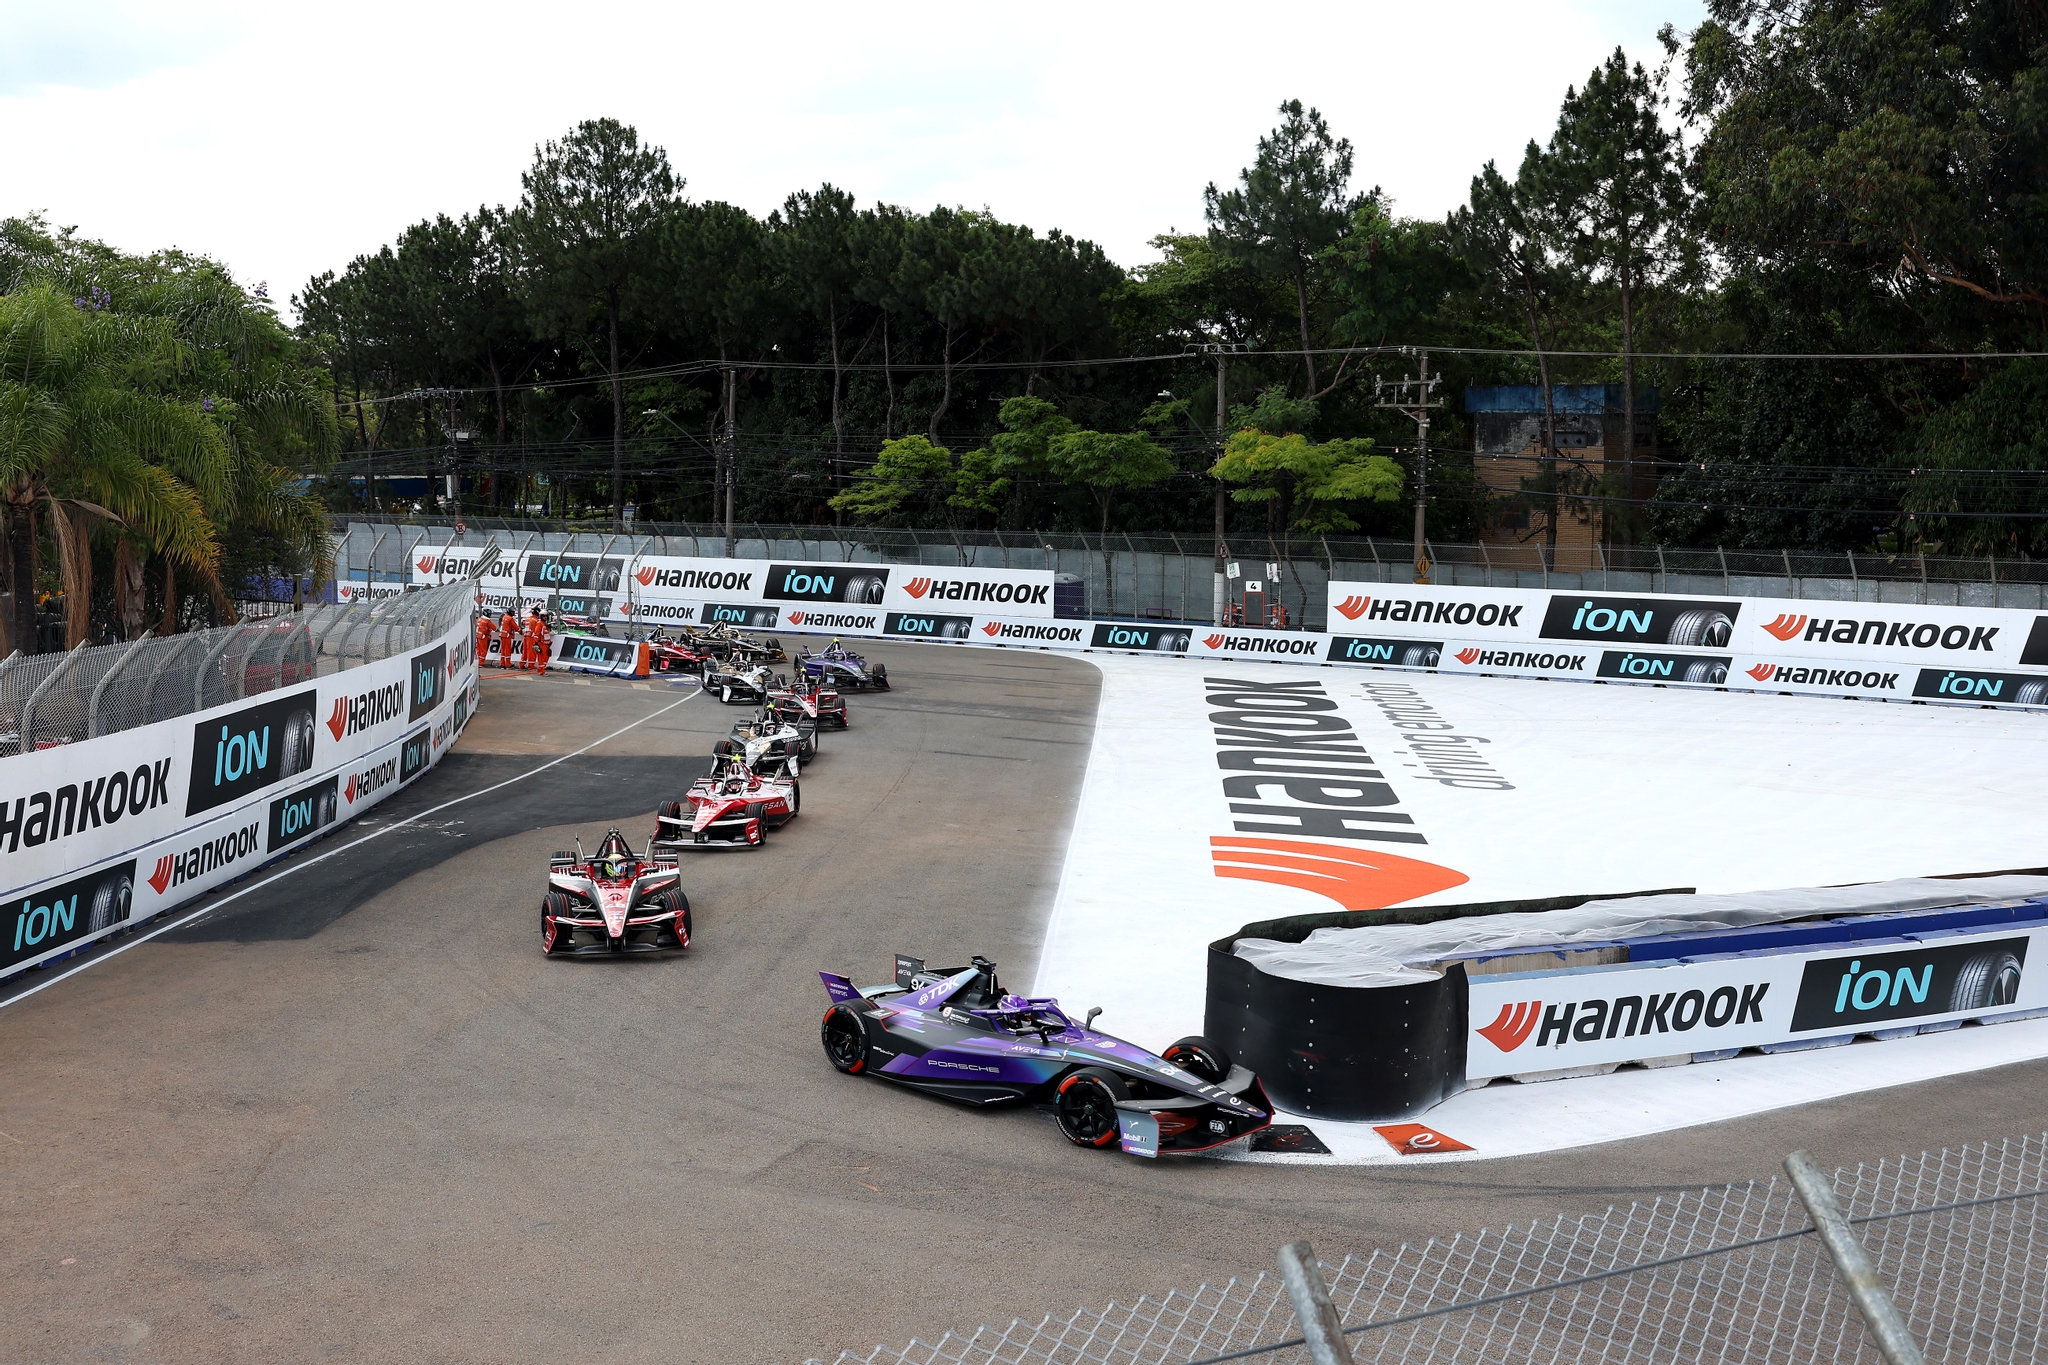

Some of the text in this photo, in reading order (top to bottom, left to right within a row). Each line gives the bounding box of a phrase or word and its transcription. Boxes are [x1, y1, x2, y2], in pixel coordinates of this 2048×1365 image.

[540, 559, 580, 582] iON
[655, 569, 752, 590] Hankook
[783, 569, 834, 594] iON
[929, 578, 1049, 605] Hankook
[713, 605, 746, 623] iON
[803, 613, 876, 629] Hankook
[898, 614, 934, 633] iON
[1368, 597, 1523, 627] Hankook
[1572, 601, 1653, 633] iON
[1000, 624, 1082, 642] Hankook
[1107, 626, 1149, 646] iON
[1223, 636, 1318, 656] Hankook
[1803, 618, 2000, 652] Hankook
[573, 640, 607, 662] iON
[1346, 639, 1393, 660] iON
[1479, 650, 1586, 671] Hankook
[1619, 653, 1675, 676] iON
[1773, 665, 1899, 690] Hankook
[418, 661, 435, 705] iON
[1938, 671, 2004, 697] iON
[346, 680, 405, 737] Hankook
[1350, 682, 1516, 791] driving emotion
[214, 725, 269, 786] iON
[405, 742, 420, 773] iON
[1203, 677, 1428, 844] Hankook
[355, 756, 397, 800] Hankook
[281, 798, 313, 837] iON
[172, 821, 260, 888] Hankook
[13, 894, 77, 951] iON
[928, 976, 960, 1000] TDK
[1834, 960, 1934, 1013] iON
[1536, 982, 1771, 1048] Hankook
[927, 1059, 1000, 1074] PORSCHE
